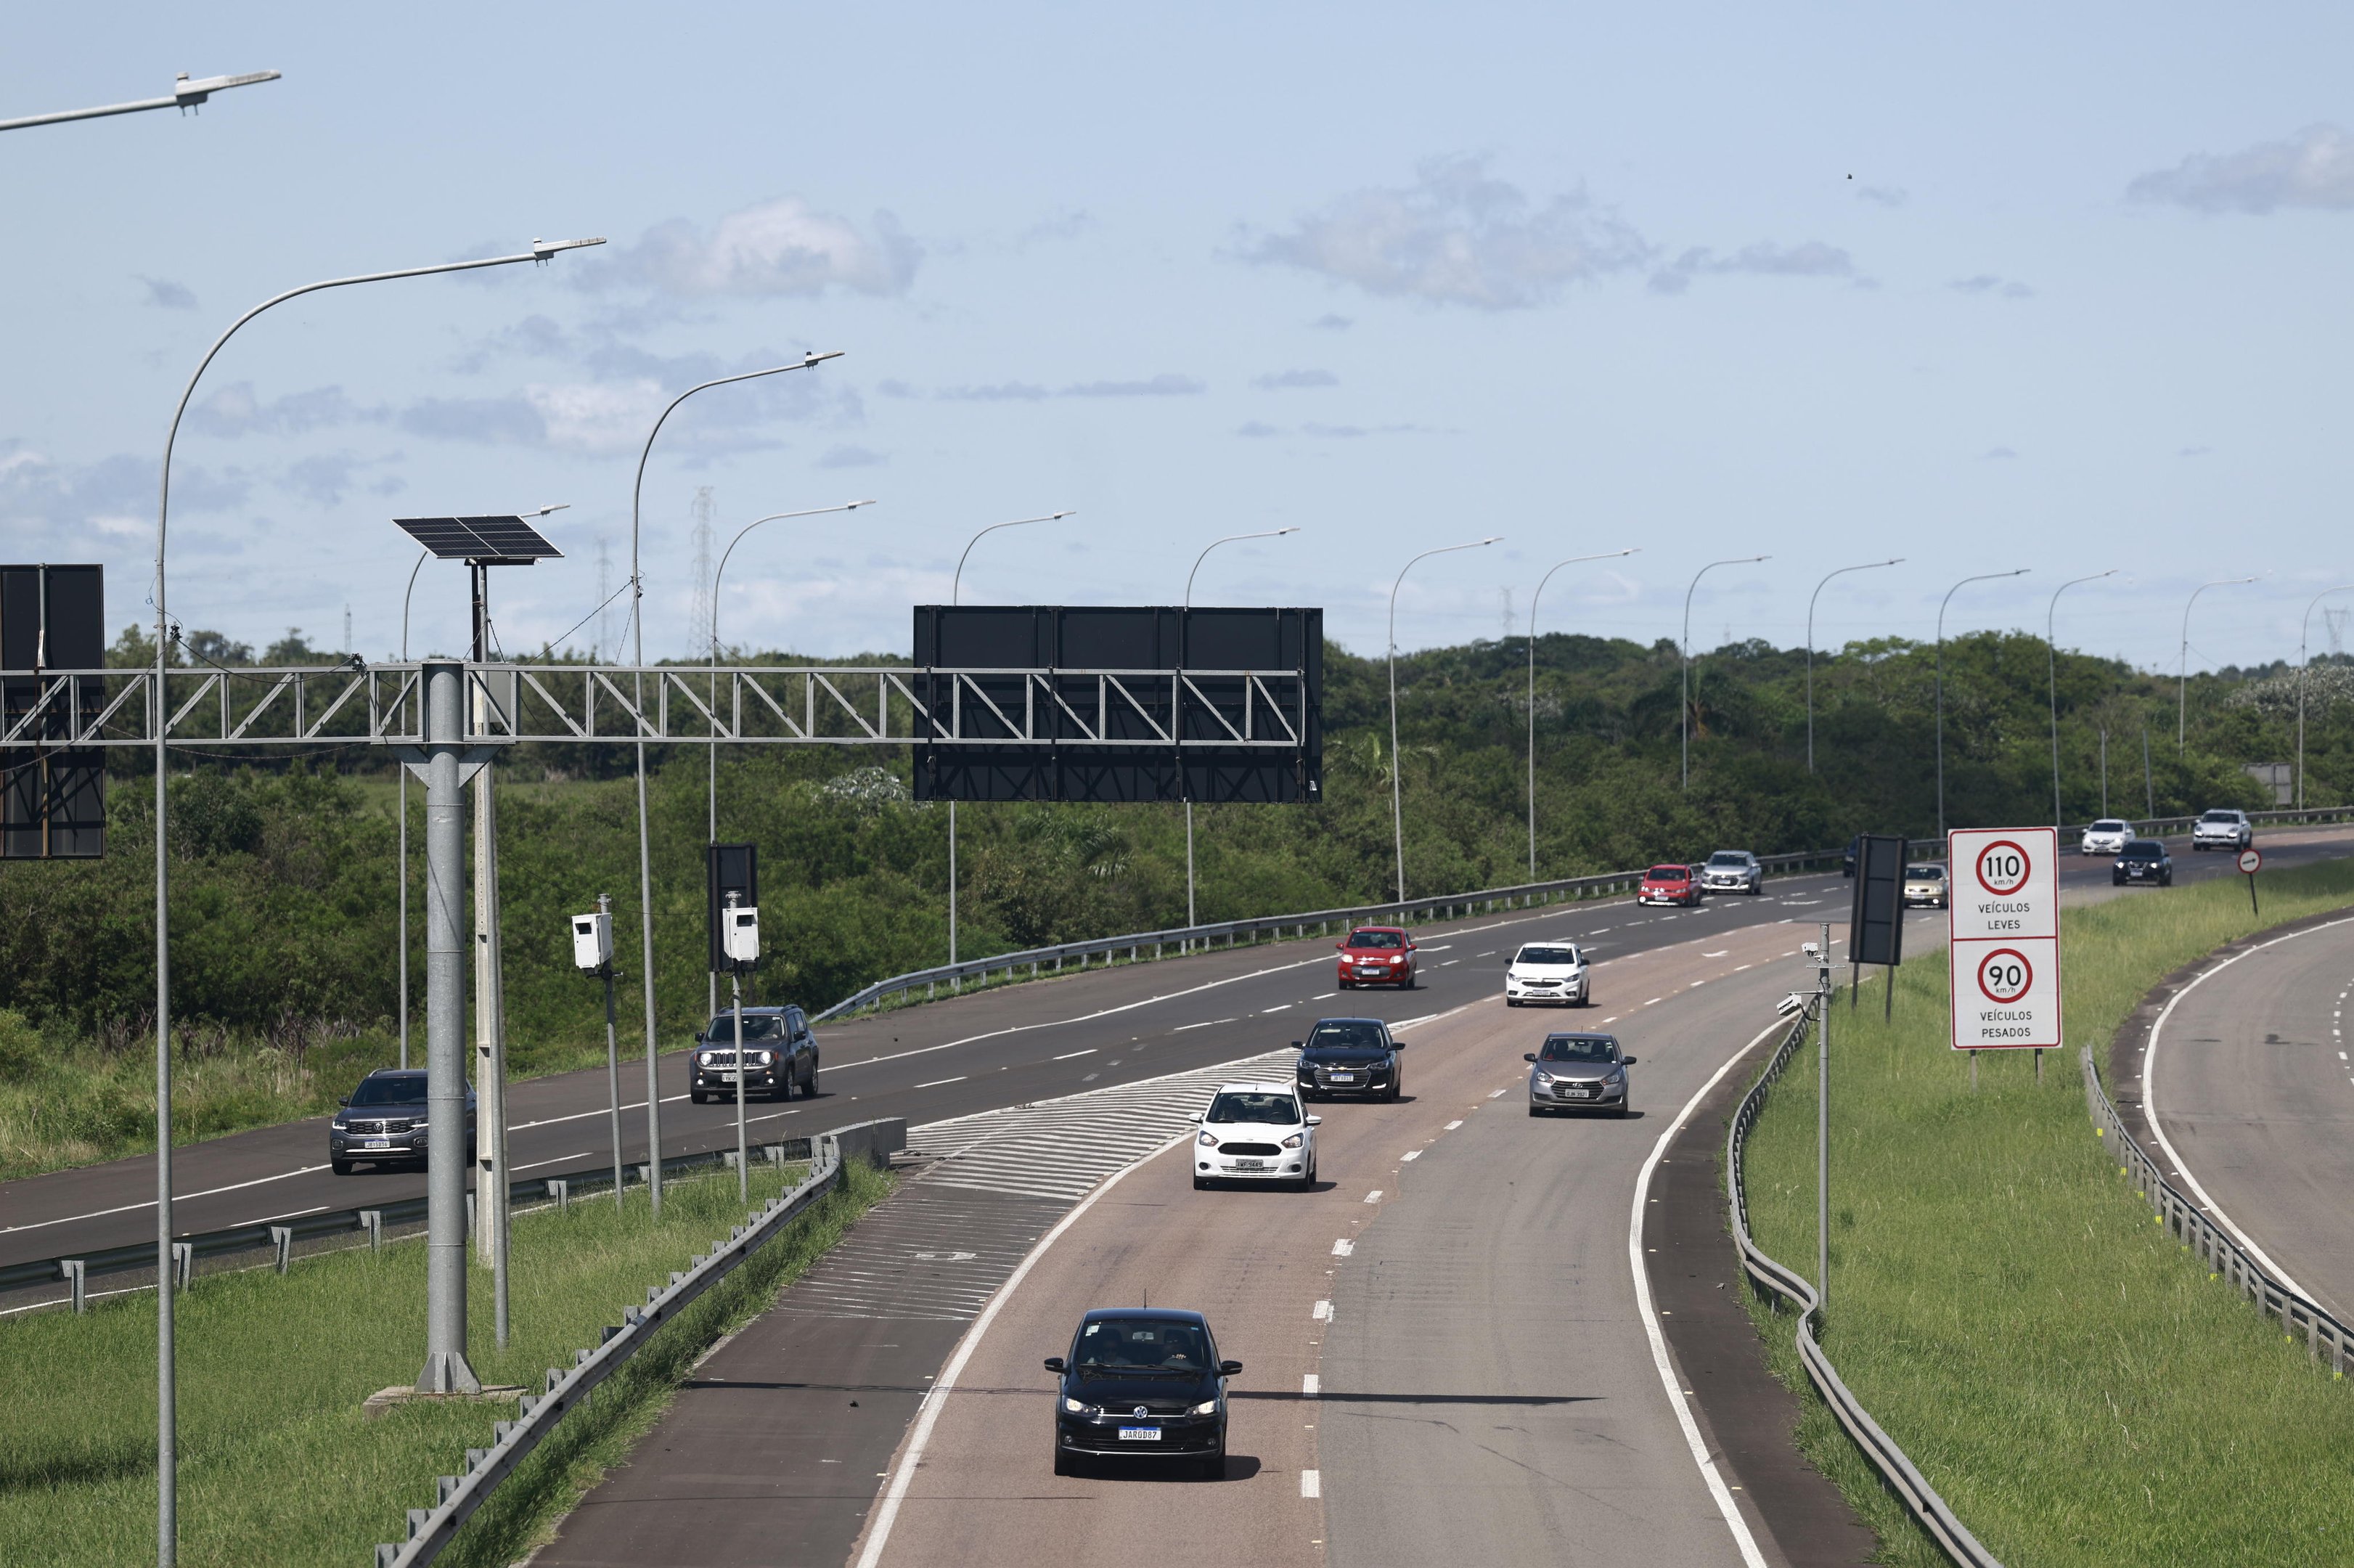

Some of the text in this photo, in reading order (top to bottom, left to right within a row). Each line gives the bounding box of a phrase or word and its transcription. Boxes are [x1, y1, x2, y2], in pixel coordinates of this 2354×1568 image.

[1986, 855, 2020, 877] 110
[1978, 900, 2030, 913] VEÍCULOS
[1988, 920, 2021, 930] LEVES
[1989, 965, 2022, 987] 90
[1980, 1008, 2032, 1021] VEÍCULOS
[1982, 1027, 2031, 1038] PESADOS
